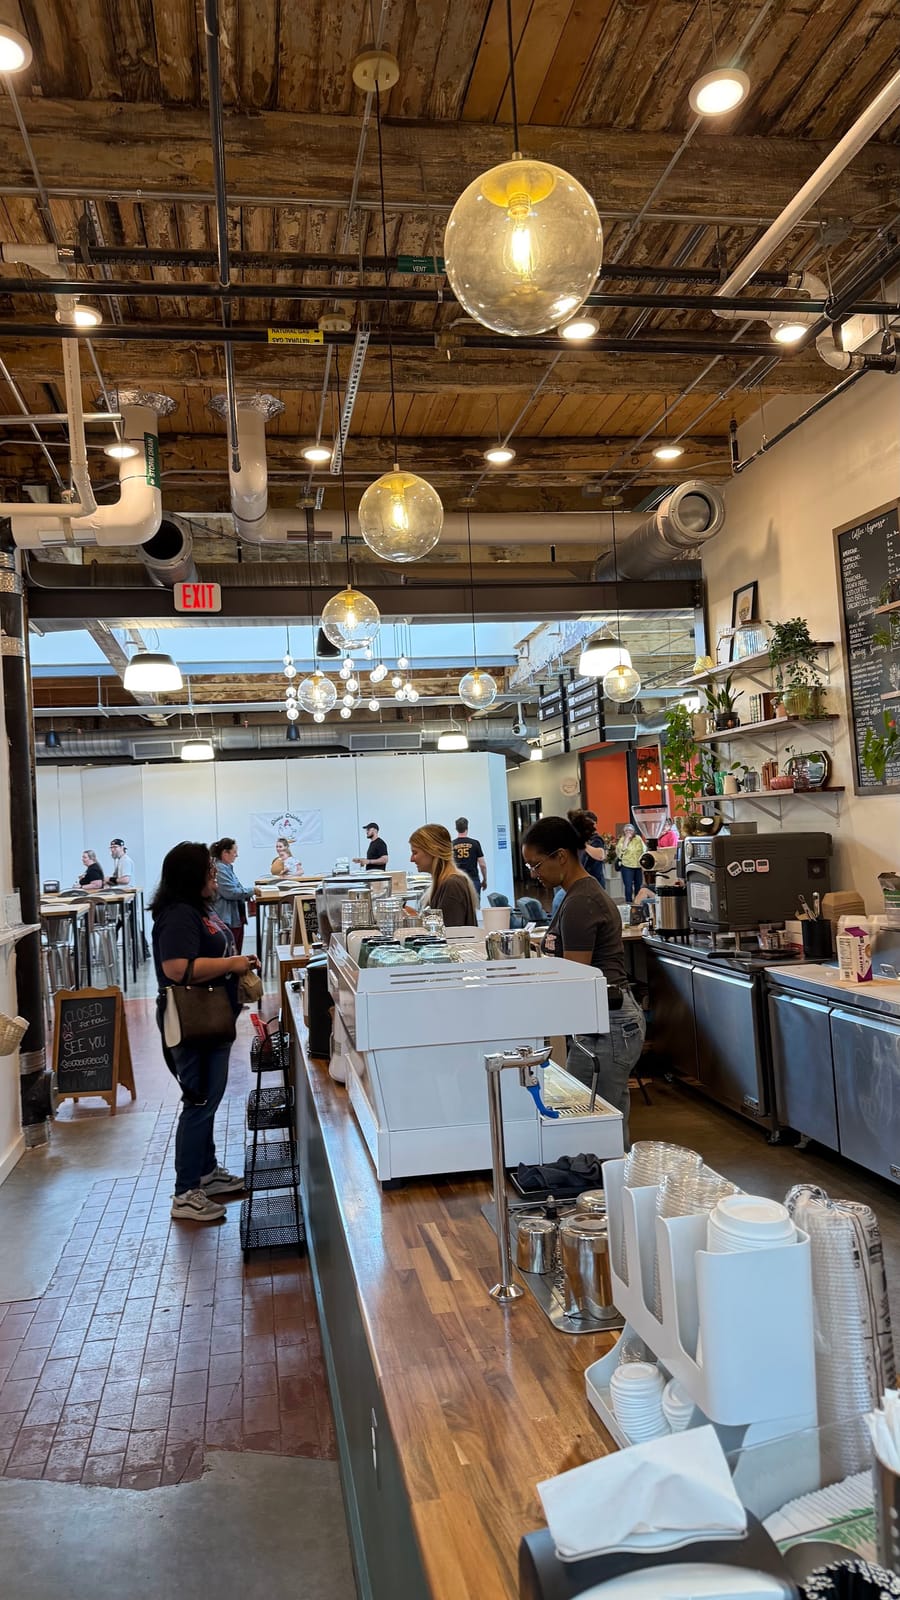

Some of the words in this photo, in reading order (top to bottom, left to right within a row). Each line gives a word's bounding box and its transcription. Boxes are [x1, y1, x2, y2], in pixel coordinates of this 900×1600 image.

[182, 584, 215, 609] EXIT
[457, 848, 470, 859] 35
[65, 1003, 103, 1023] CLOSED
[64, 1038, 88, 1057] SEE
[89, 1035, 106, 1050] YOU
